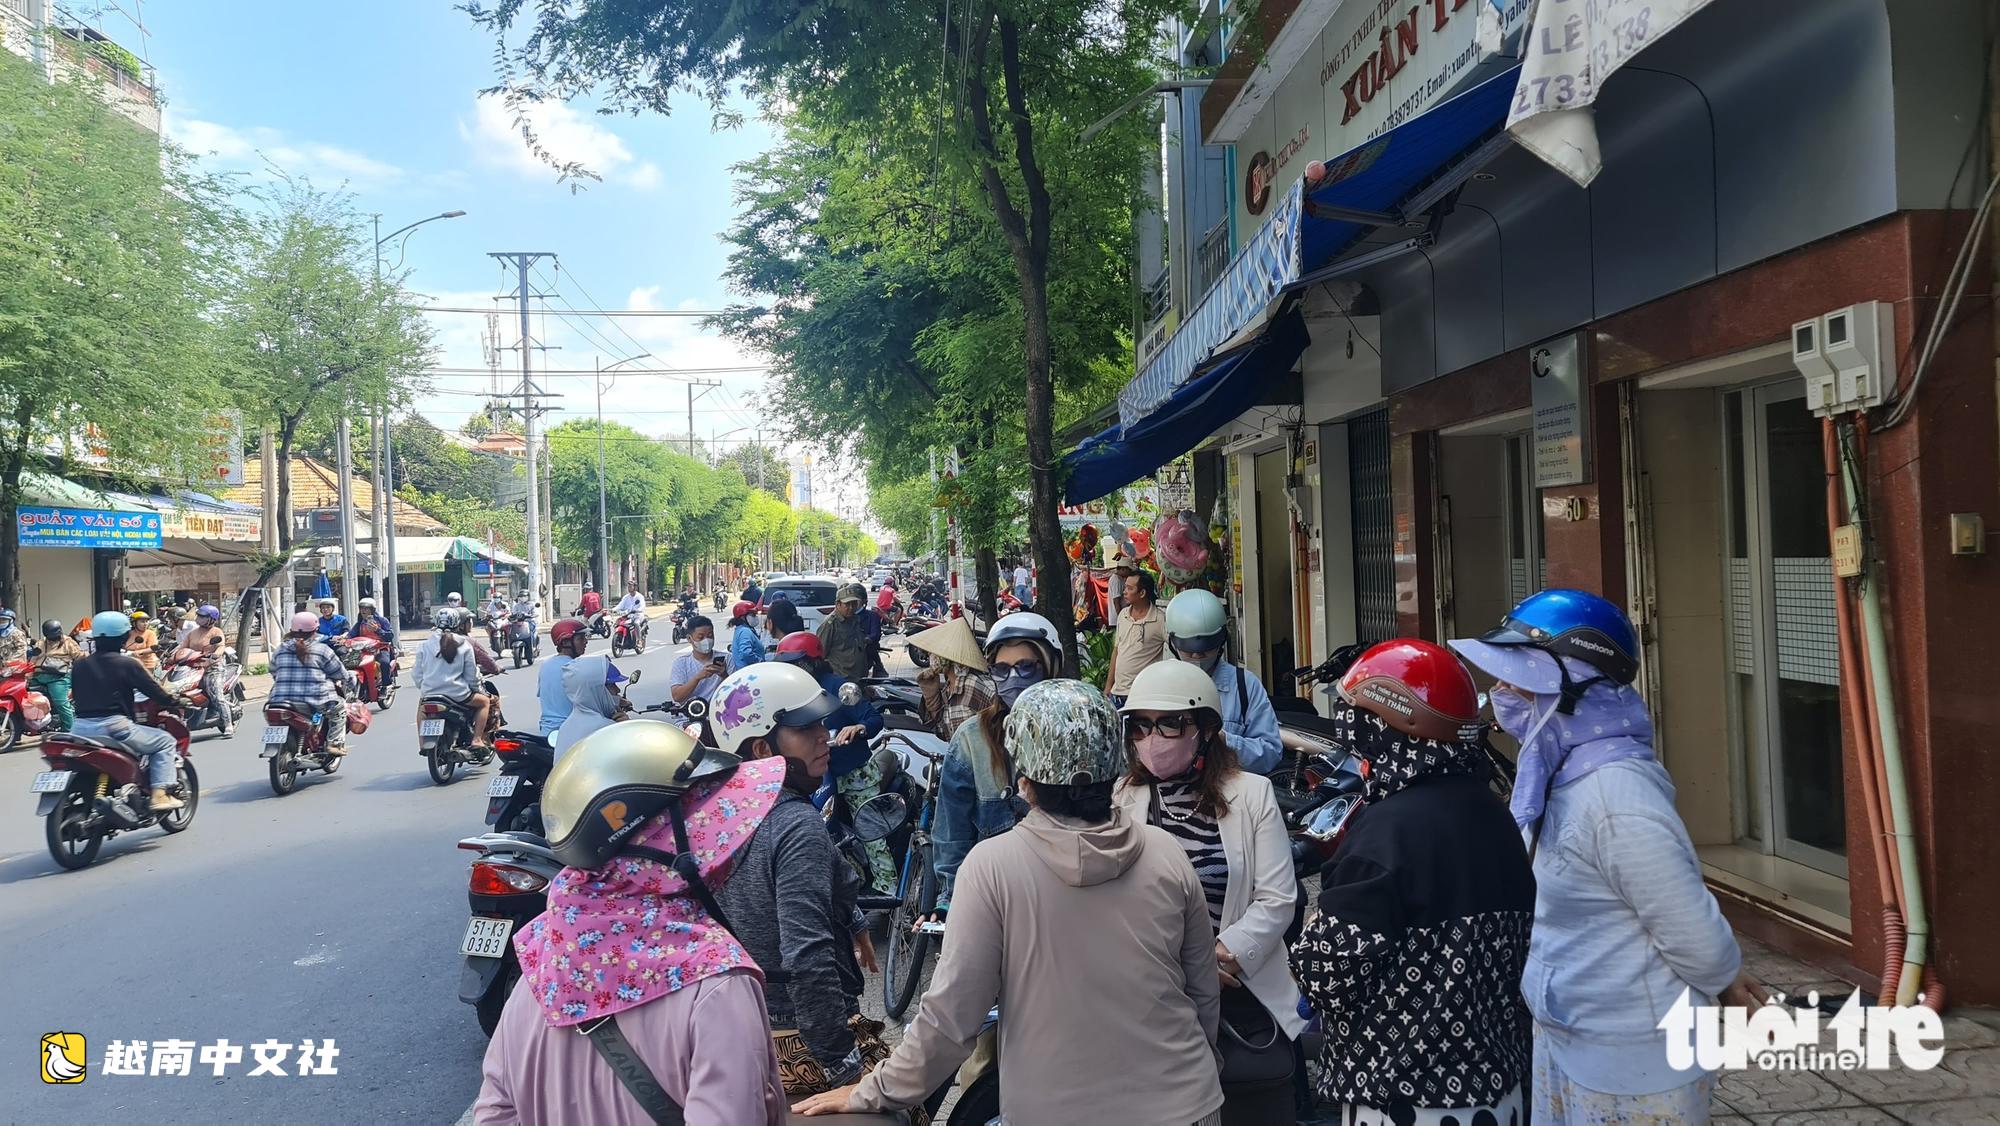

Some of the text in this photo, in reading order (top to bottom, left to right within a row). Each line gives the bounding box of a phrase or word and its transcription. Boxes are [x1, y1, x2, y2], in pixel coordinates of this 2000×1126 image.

[1320, 54, 1340, 86] CÔNG
[1340, 40, 1351, 64] TY
[1352, 9, 1376, 51] TNHH
[1340, 5, 1419, 126] XUÂN
[20, 510, 76, 526] QUẦY
[80, 513, 114, 527] VẢI
[120, 515, 143, 527] SỐ
[148, 519, 158, 528] 5
[207, 518, 224, 536] ĐẠT
[1570, 637, 1614, 656] vinaphone
[608, 815, 646, 843] PETROLIMEX
[467, 937, 500, 953] 0383
